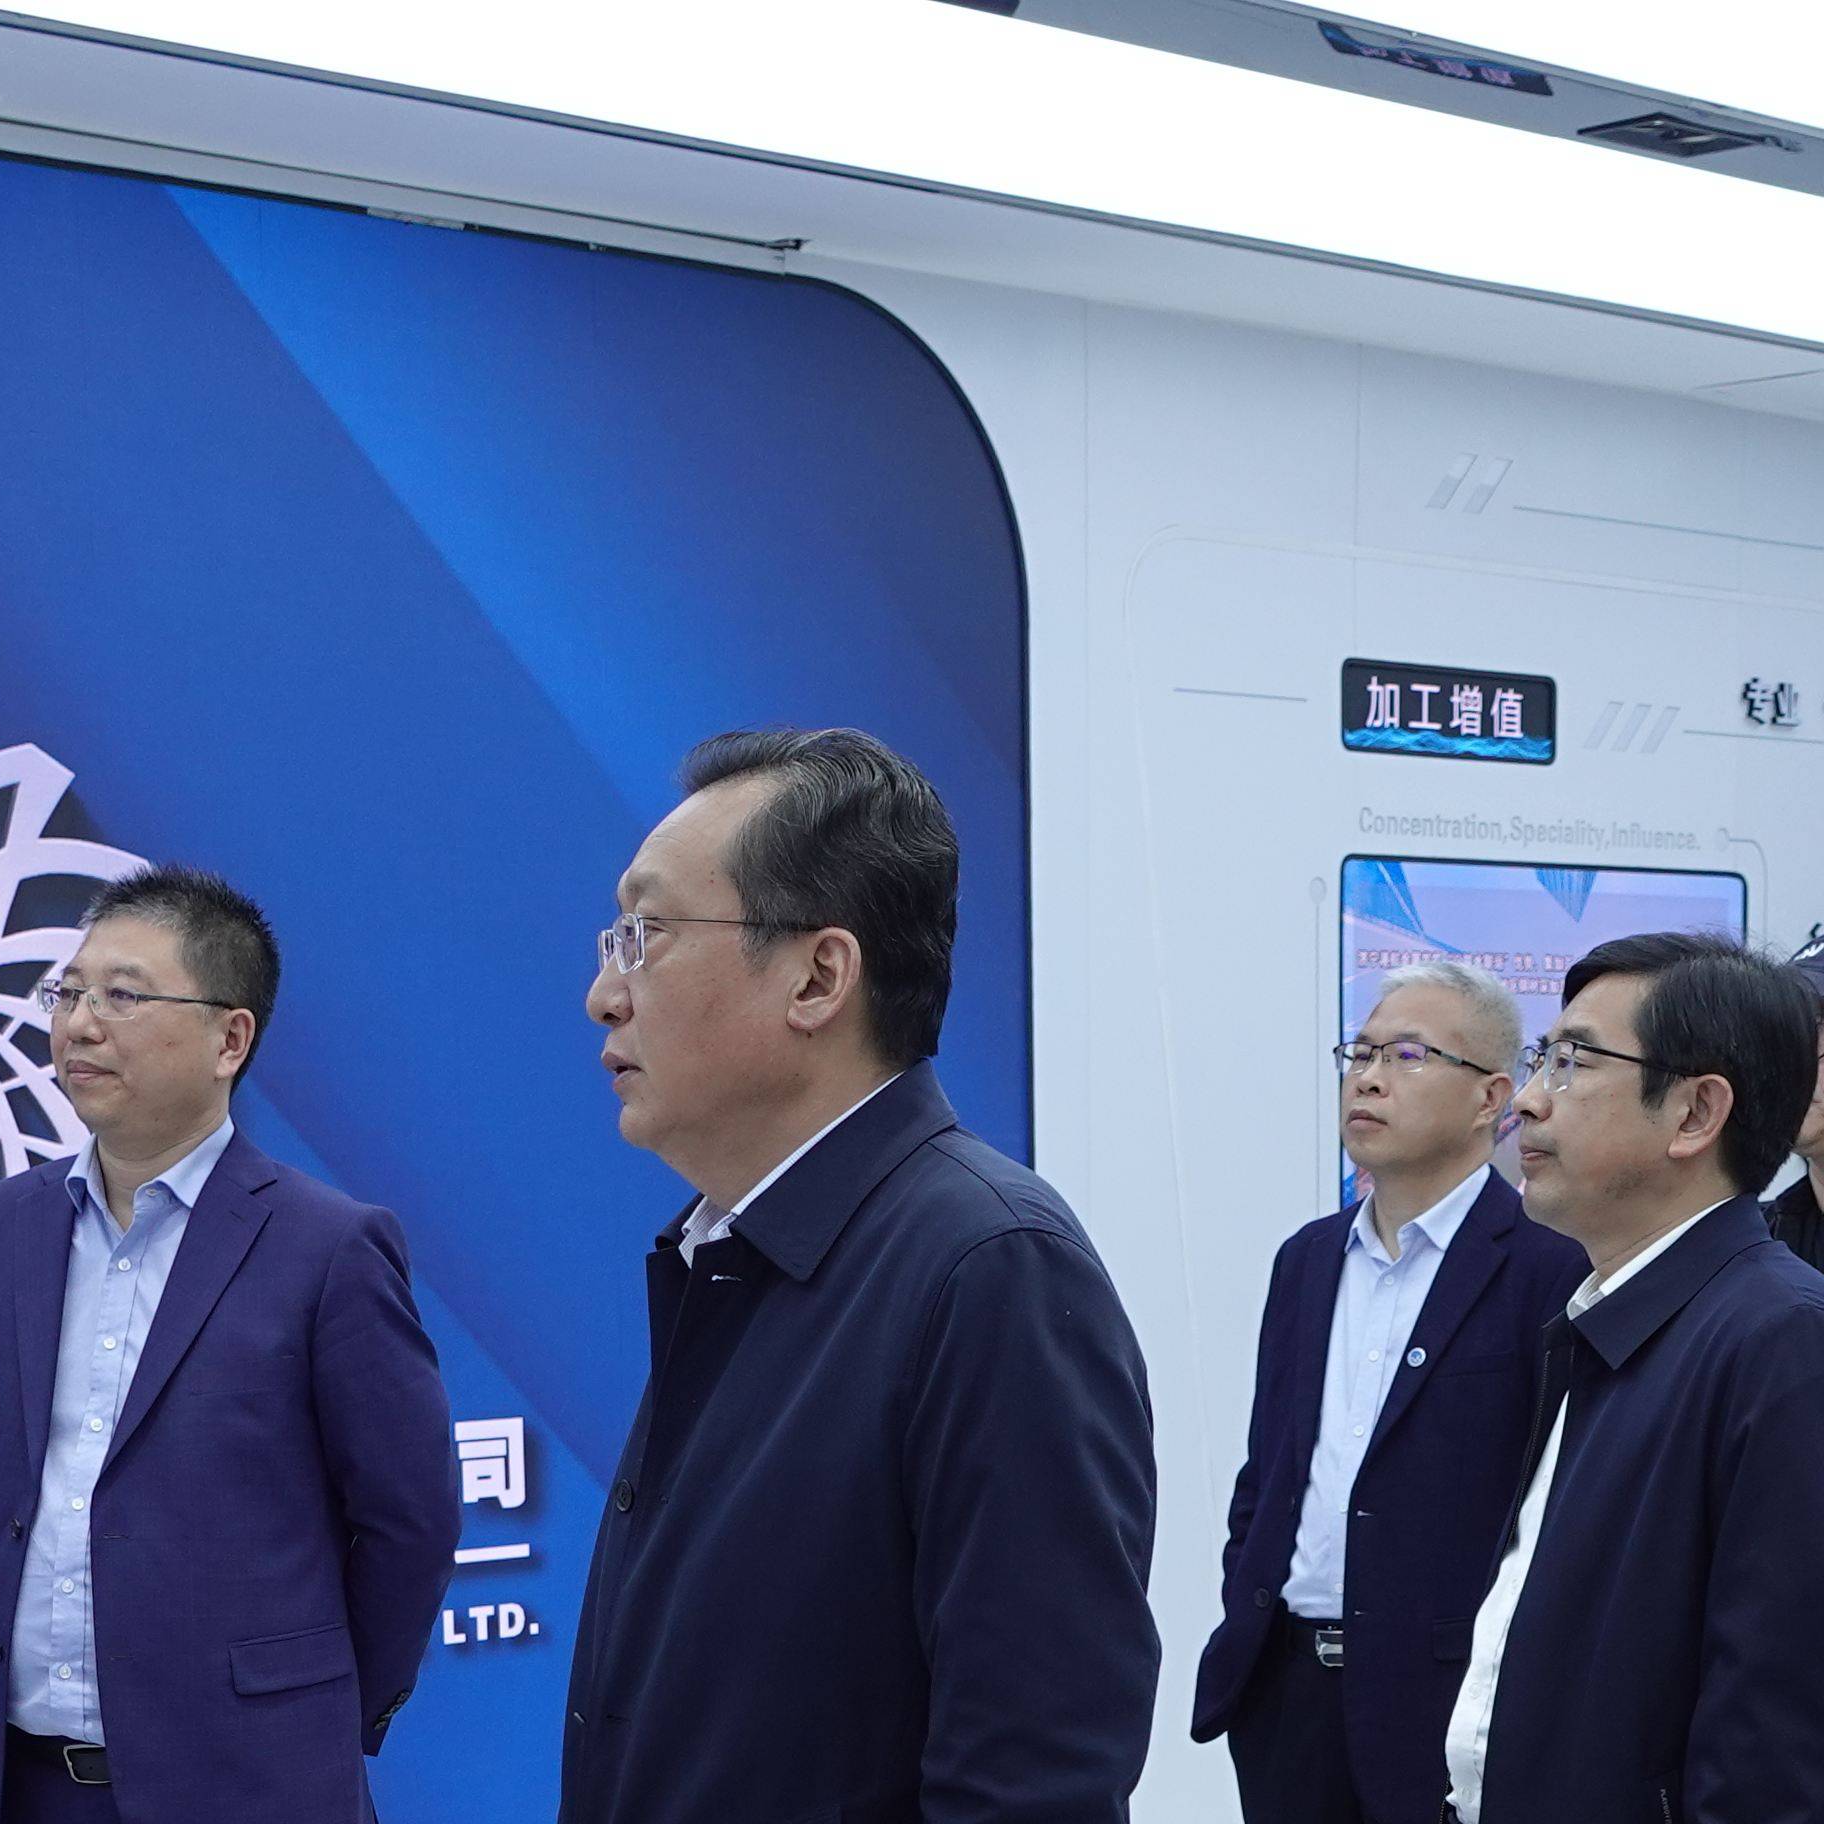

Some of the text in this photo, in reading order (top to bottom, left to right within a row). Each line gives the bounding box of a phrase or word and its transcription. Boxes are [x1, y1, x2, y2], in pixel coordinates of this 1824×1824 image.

[1365, 676, 1524, 738] 加工增值
[454, 1416, 526, 1509] 司
[442, 1602, 540, 1646] LTD.
